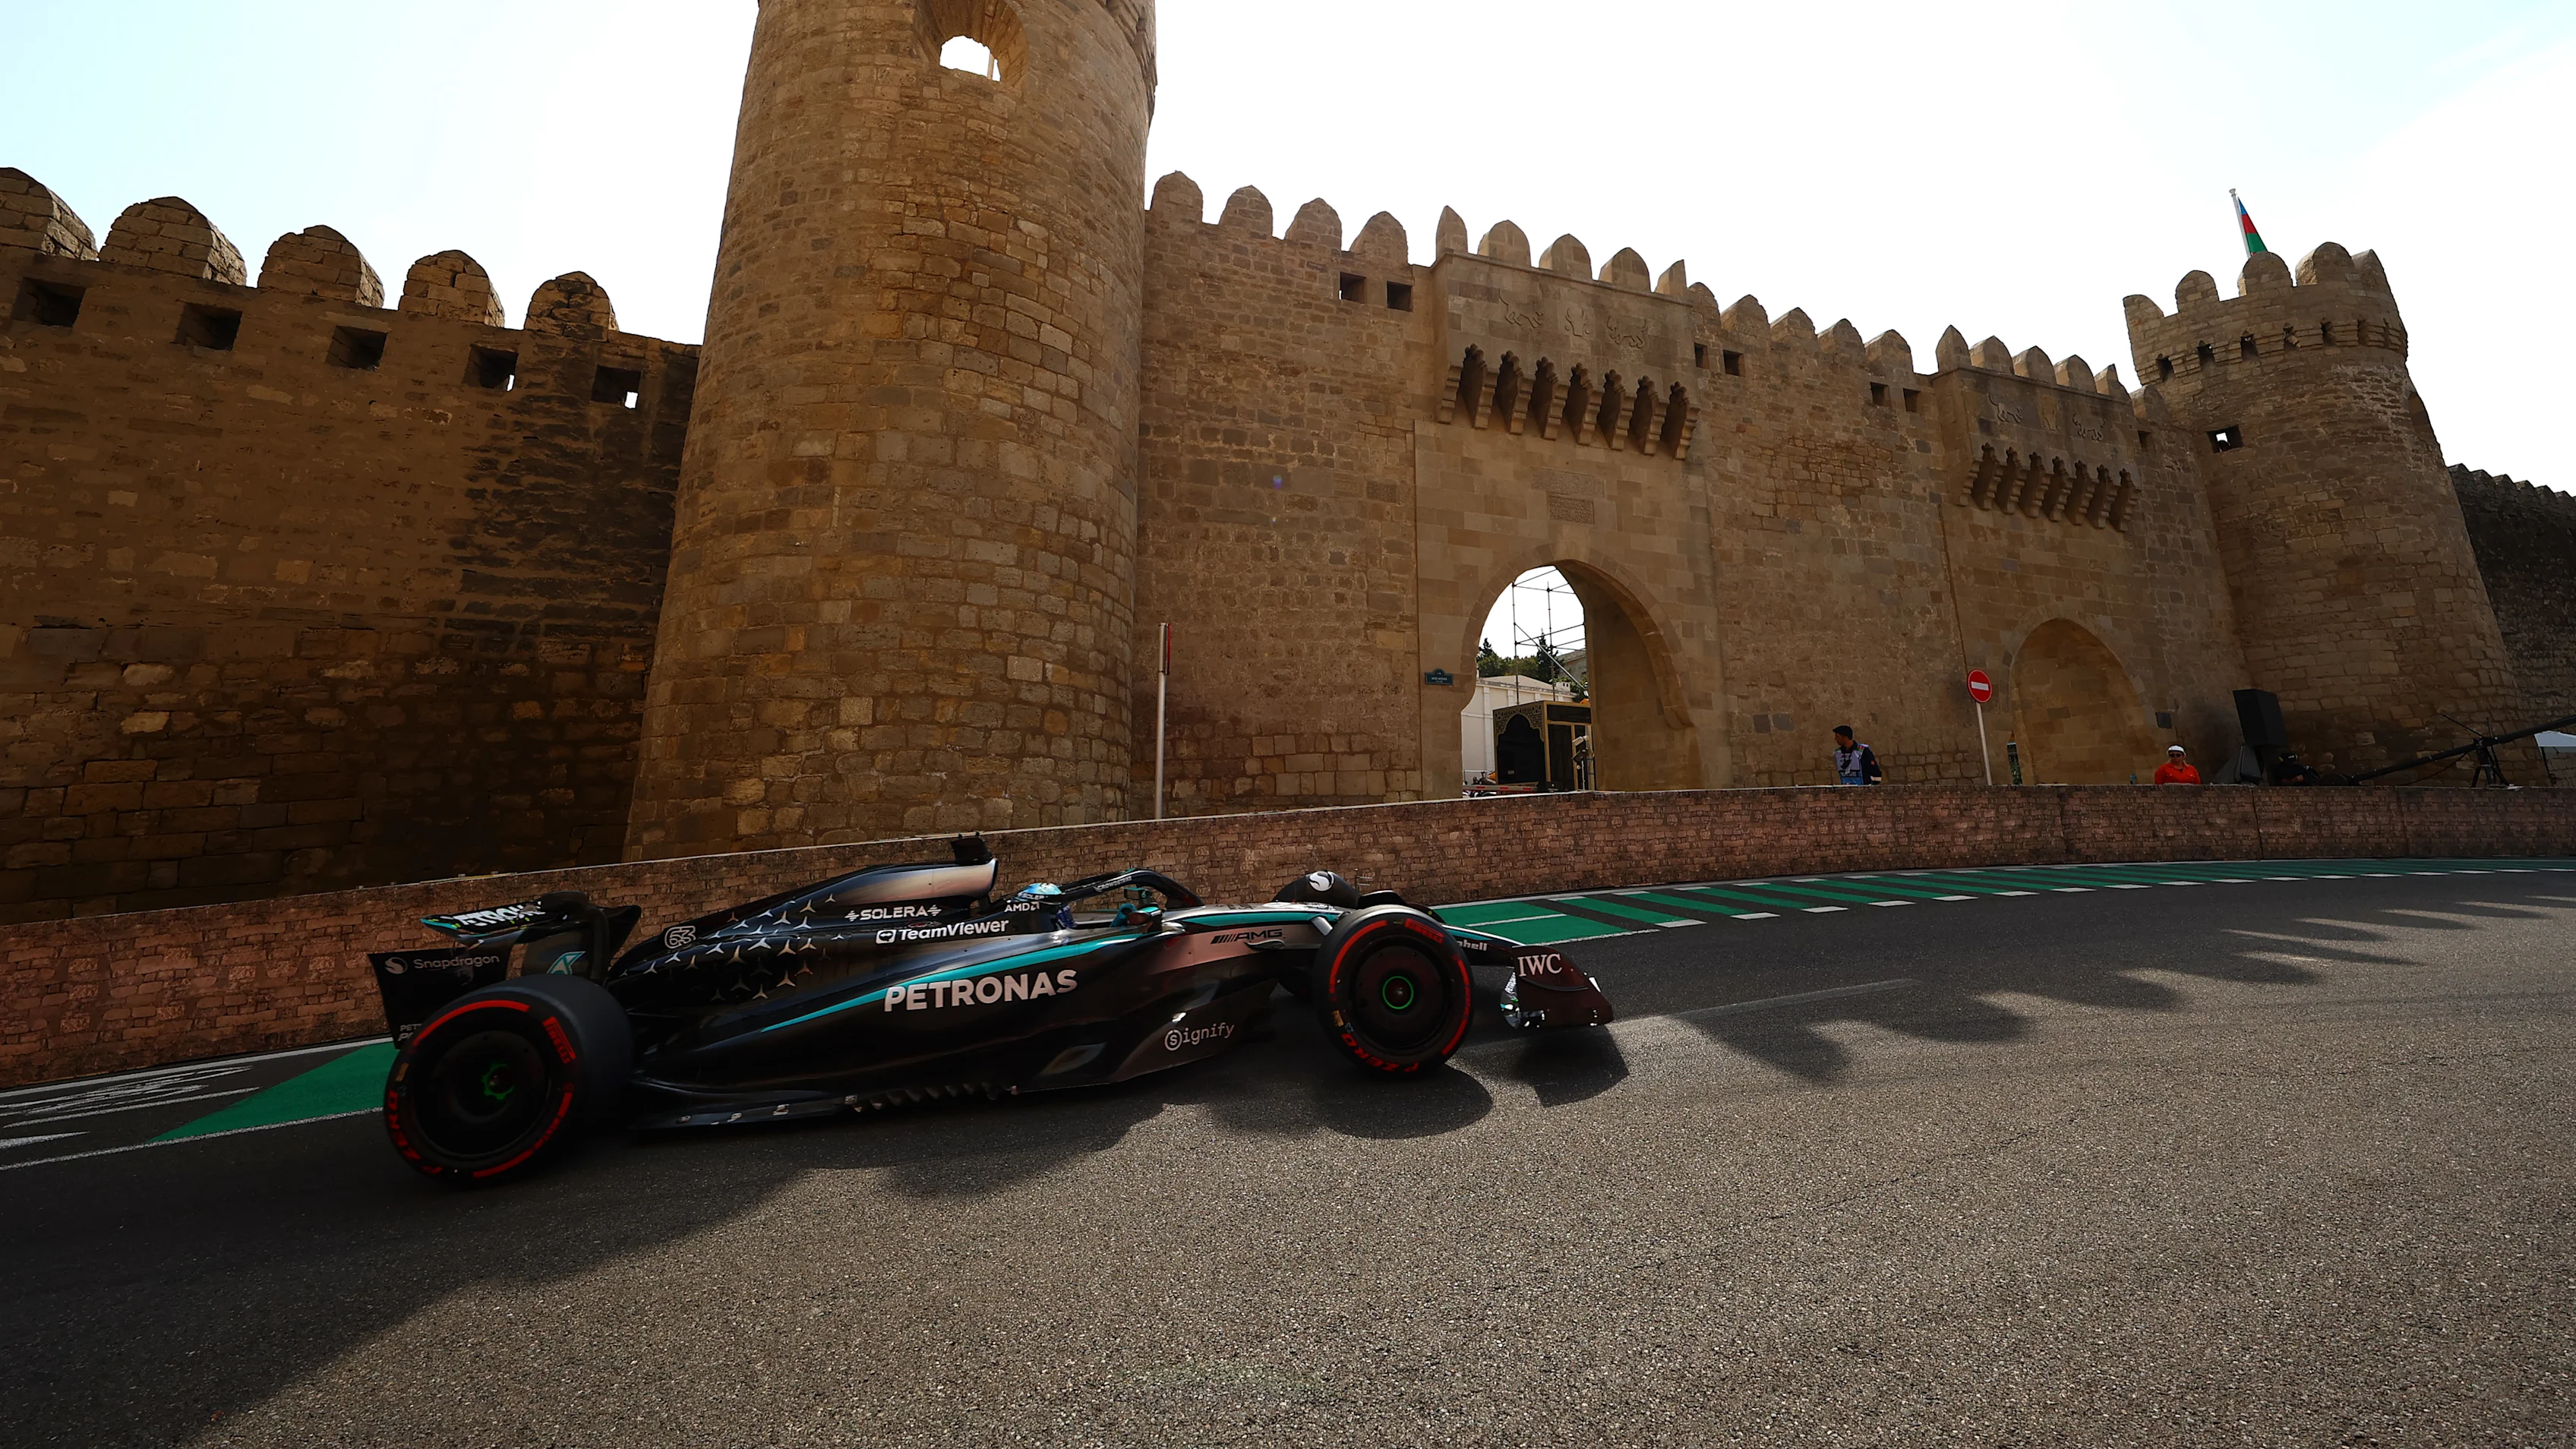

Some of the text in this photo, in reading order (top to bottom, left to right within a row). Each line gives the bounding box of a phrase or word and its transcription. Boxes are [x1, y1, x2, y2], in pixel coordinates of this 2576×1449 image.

[860, 905, 928, 921] SOLERA
[1004, 902, 1031, 913] AMD
[665, 925, 696, 949] 63
[898, 920, 1009, 941] TeamViewer
[1234, 929, 1283, 942] AMG
[413, 955, 500, 969] Snapdragon
[1517, 953, 1562, 977] IWC
[884, 970, 1078, 1012] PETRONAS
[1341, 1033, 1400, 1072] ZERO
